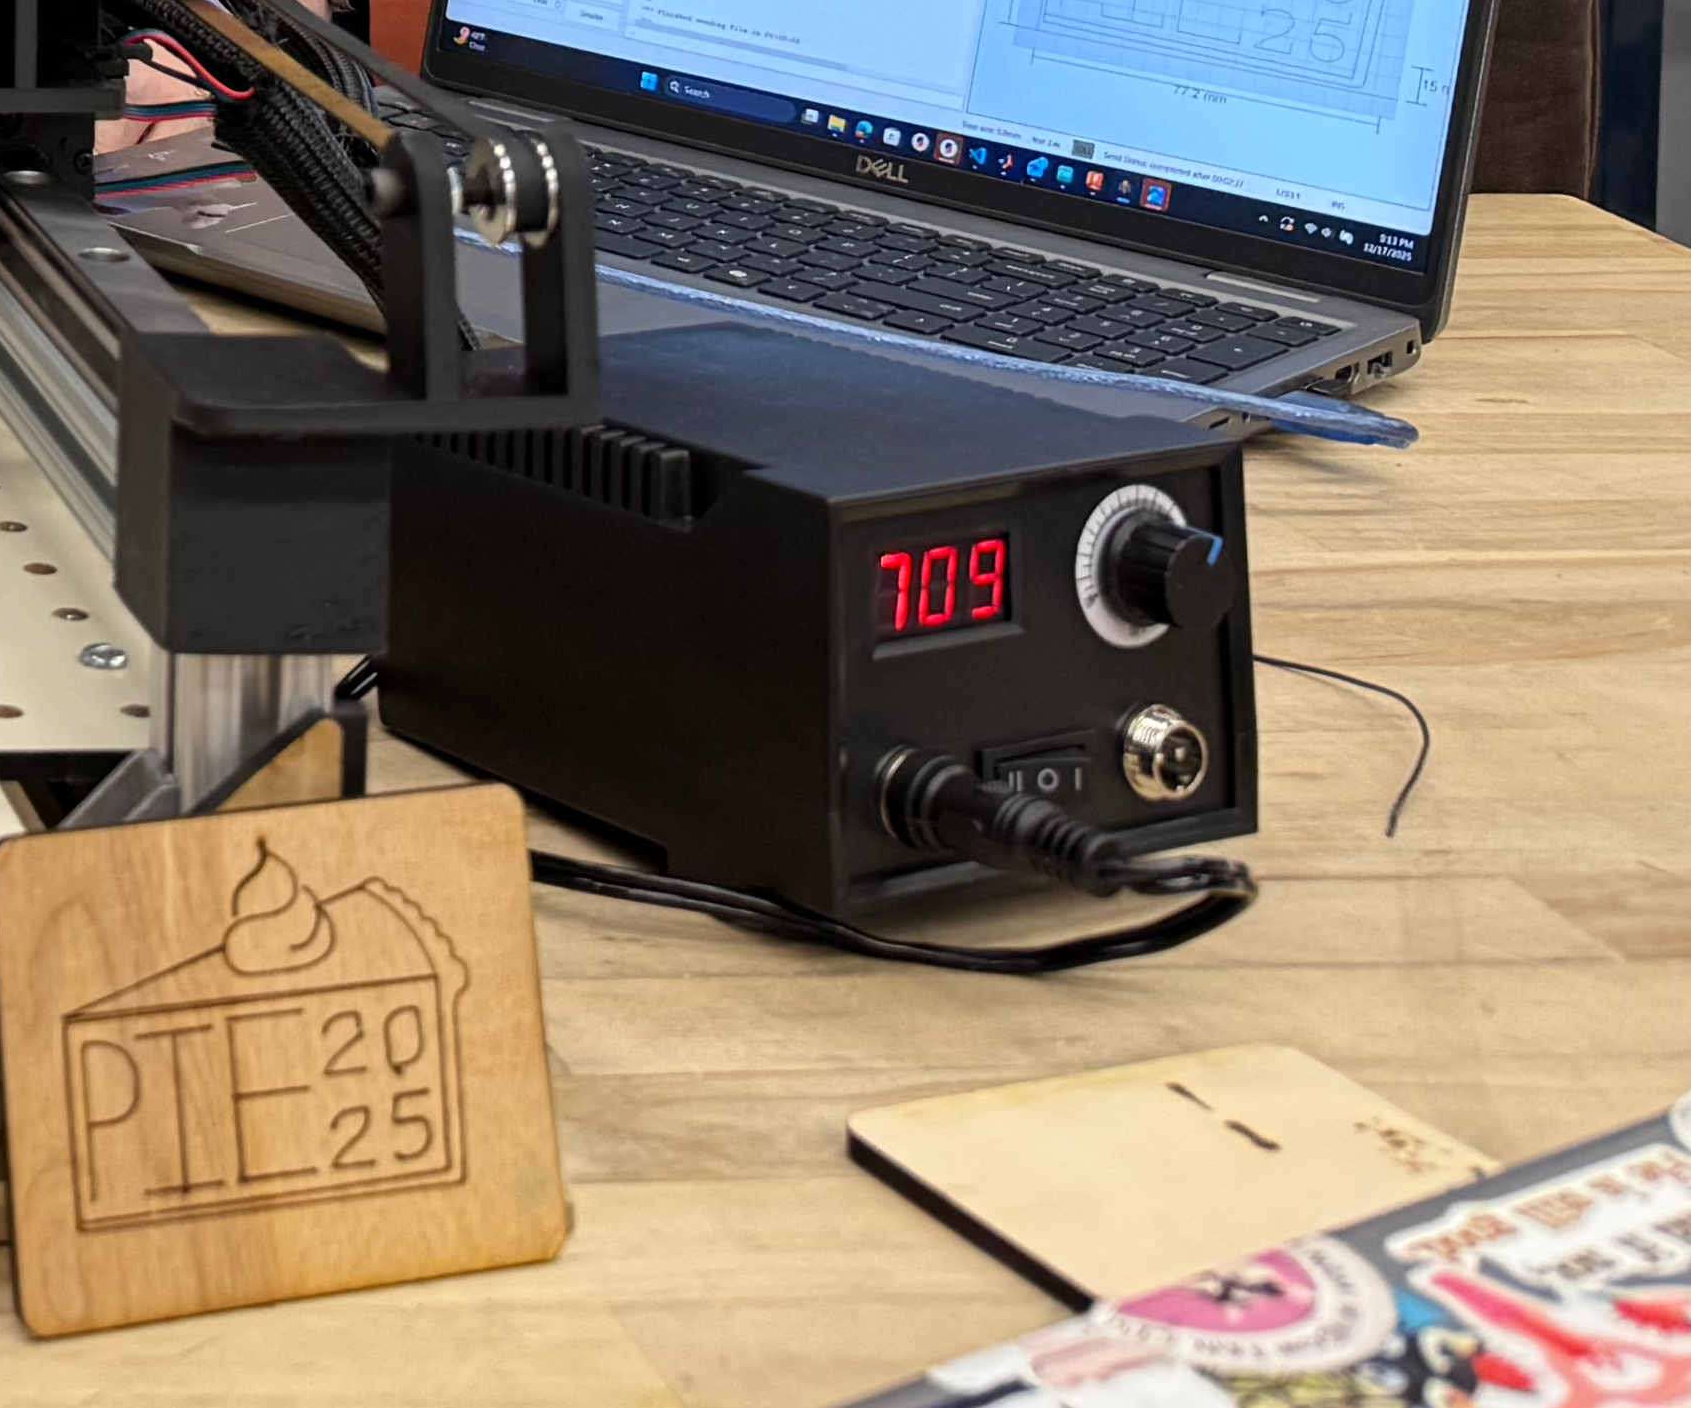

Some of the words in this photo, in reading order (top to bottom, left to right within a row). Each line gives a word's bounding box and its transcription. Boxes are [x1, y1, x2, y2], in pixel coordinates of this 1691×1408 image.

[1253, 9, 1353, 64] 25
[1203, 90, 1228, 105] mm
[855, 154, 909, 184] DELL
[879, 537, 1006, 632] 709
[78, 1006, 320, 1204] PIE
[320, 1003, 426, 1077] 20
[328, 1087, 436, 1172] 25
